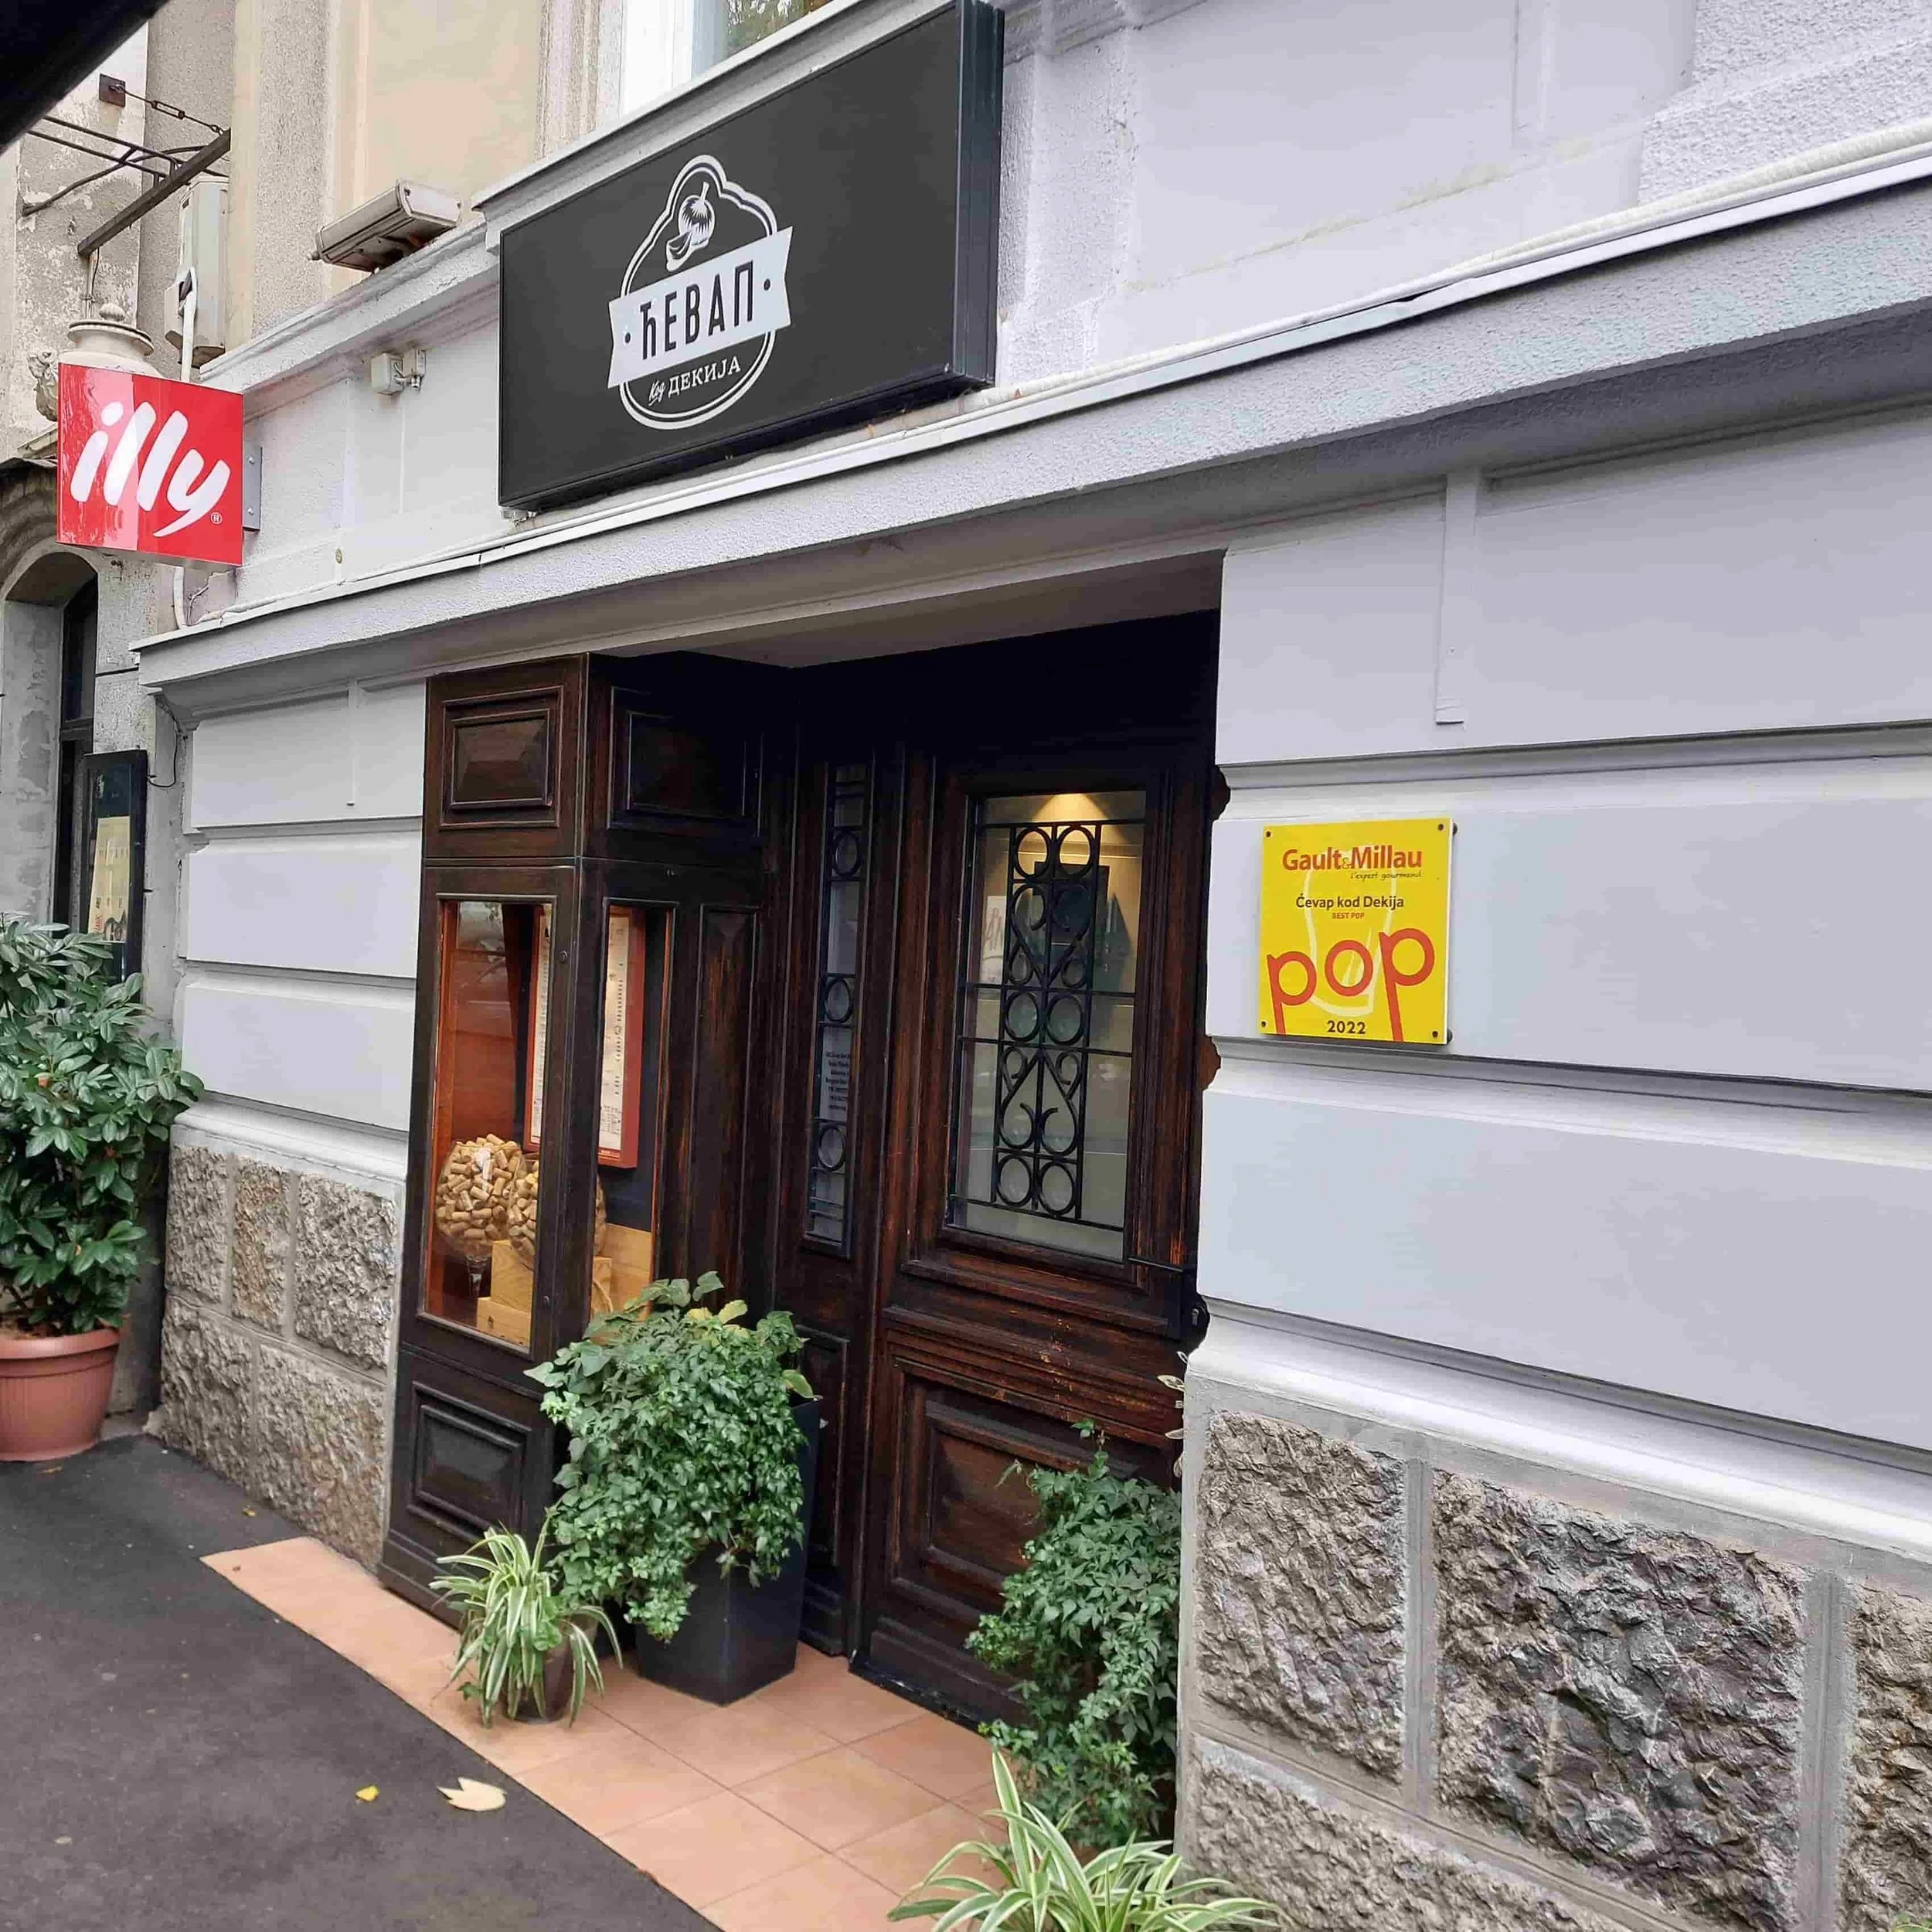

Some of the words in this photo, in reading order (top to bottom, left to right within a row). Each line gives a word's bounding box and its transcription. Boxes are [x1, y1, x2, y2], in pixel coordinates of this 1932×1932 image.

[640, 260, 753, 360] ЋЕВАП
[668, 355, 741, 398] ДЕКИЈА
[70, 401, 230, 537] illy
[1296, 893, 1334, 910] Ćevap
[1337, 896, 1360, 908] kod
[1363, 895, 1404, 910] Dekija
[1267, 928, 1435, 1043] pop
[1327, 1020, 1366, 1035] 2022
